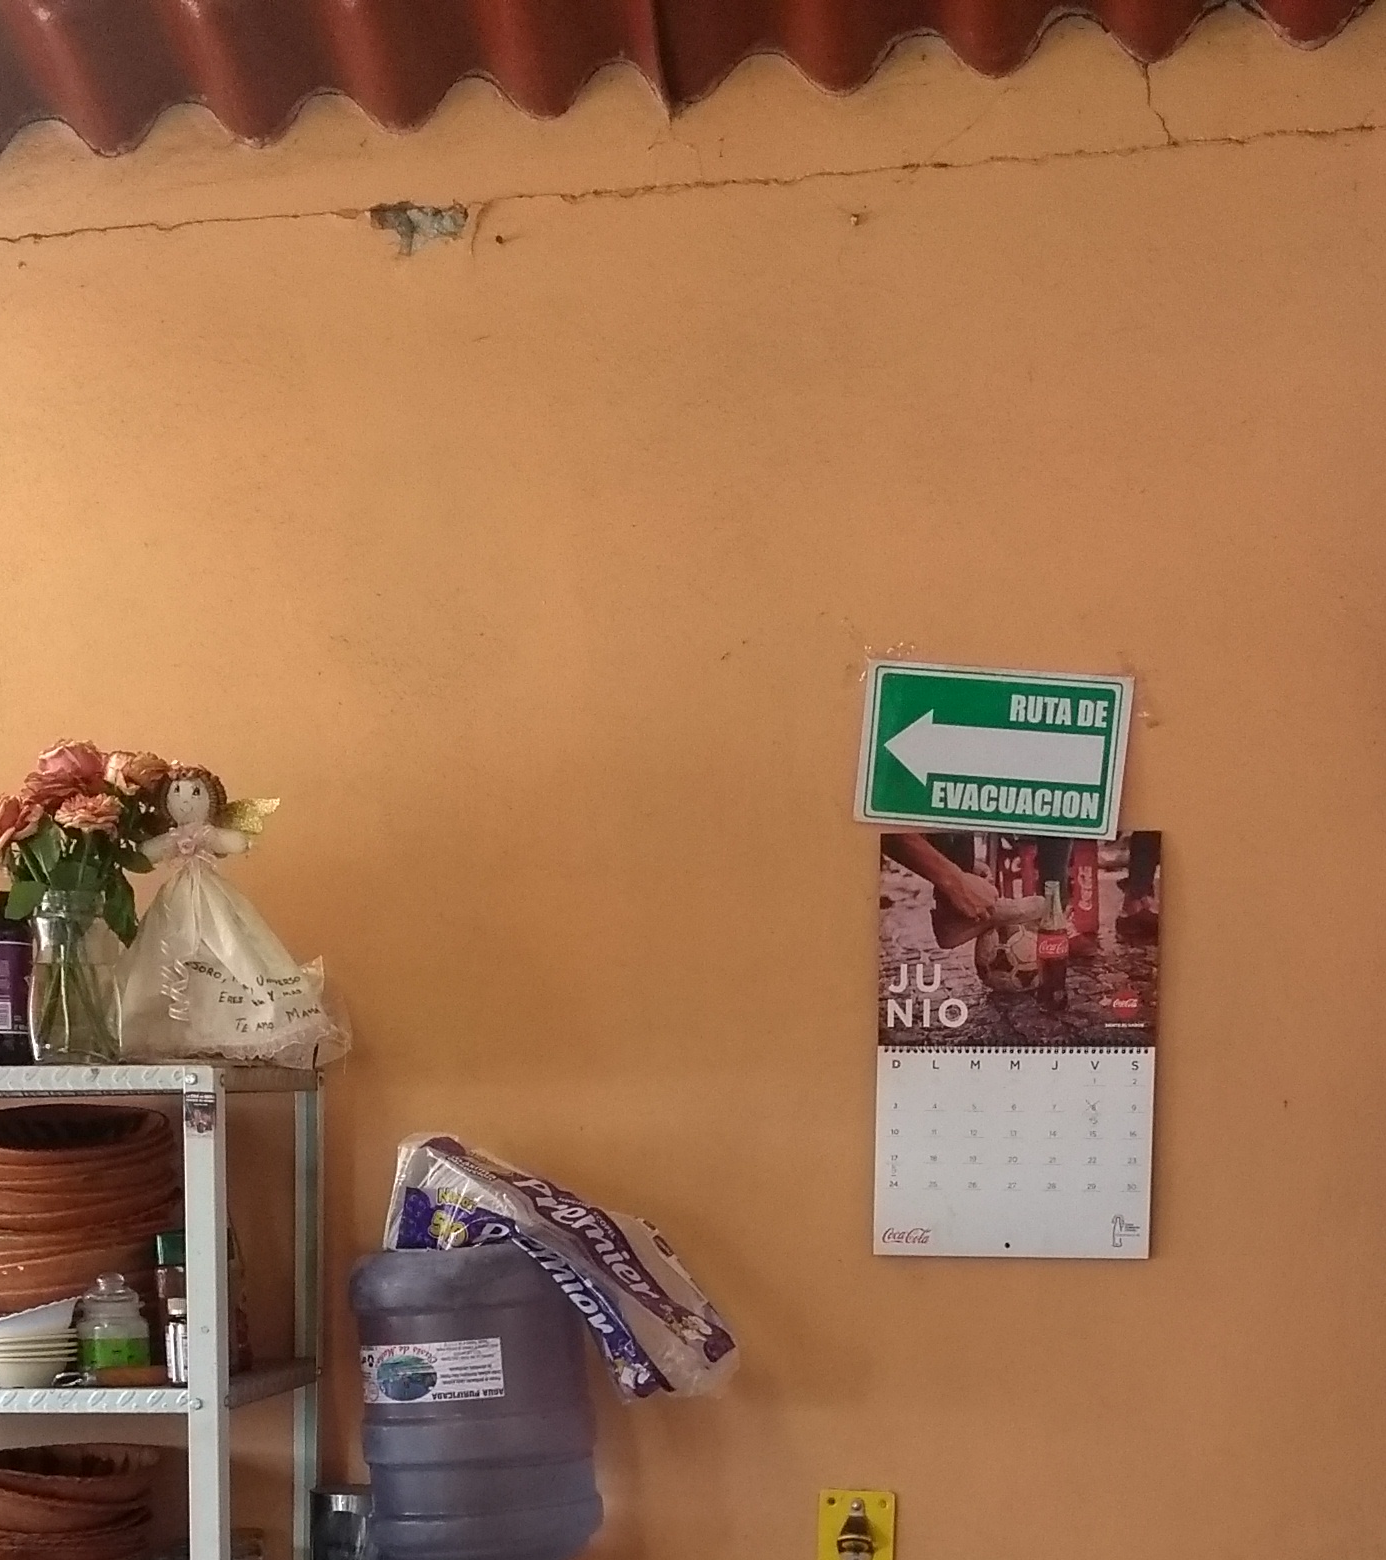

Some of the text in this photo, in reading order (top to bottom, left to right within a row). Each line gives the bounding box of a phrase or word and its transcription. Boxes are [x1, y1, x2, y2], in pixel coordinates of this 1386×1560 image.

[1009, 693, 1108, 728] RUTA DE
[930, 780, 1100, 820] EVACUACION
[888, 964, 942, 994] JU
[886, 998, 969, 1029] NIO
[892, 1060, 1140, 1071] D L M M J V S
[513, 1178, 661, 1300] Premier
[482, 1388, 504, 1398] AGUA
